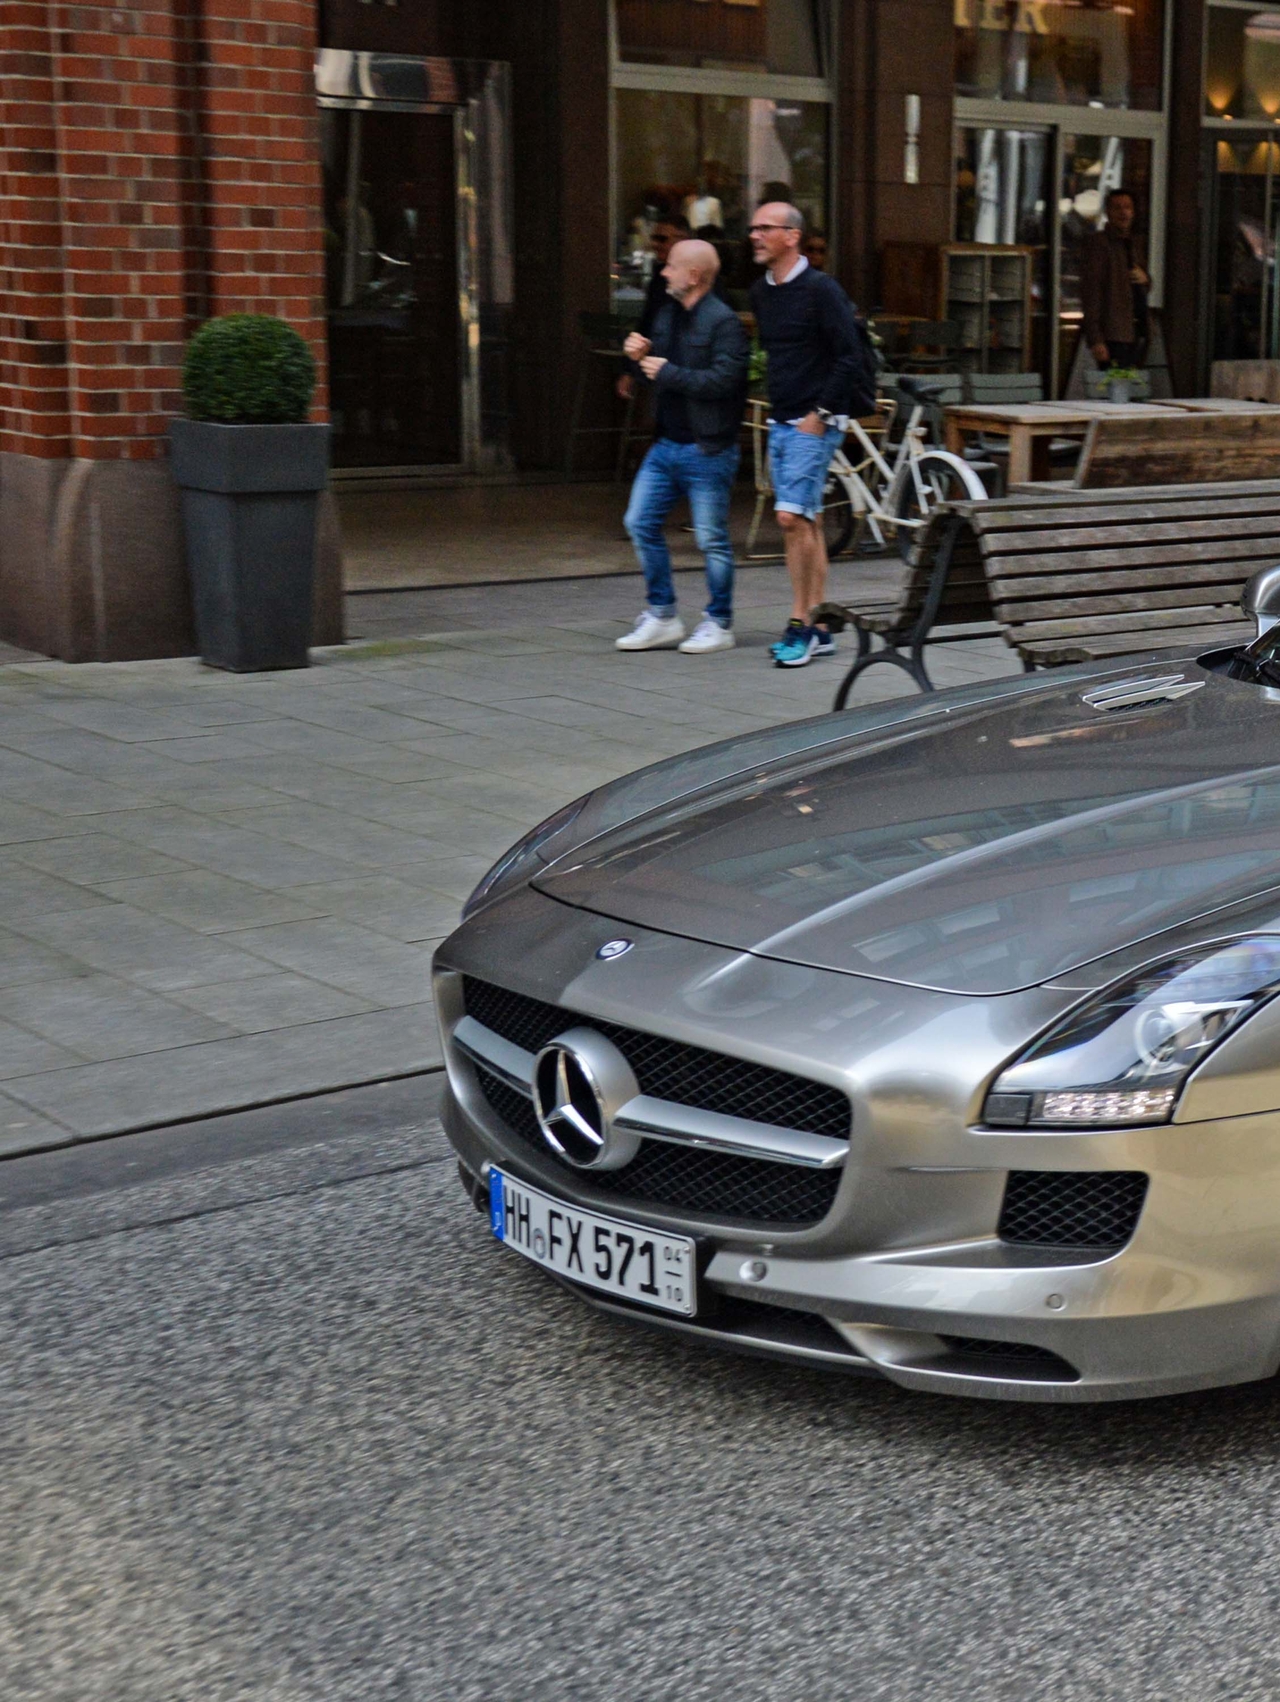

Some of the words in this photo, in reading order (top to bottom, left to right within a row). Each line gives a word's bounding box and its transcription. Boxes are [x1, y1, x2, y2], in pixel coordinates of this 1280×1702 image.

[504, 1185, 530, 1248] HH
[549, 1209, 583, 1273] FX
[594, 1226, 659, 1296] 571
